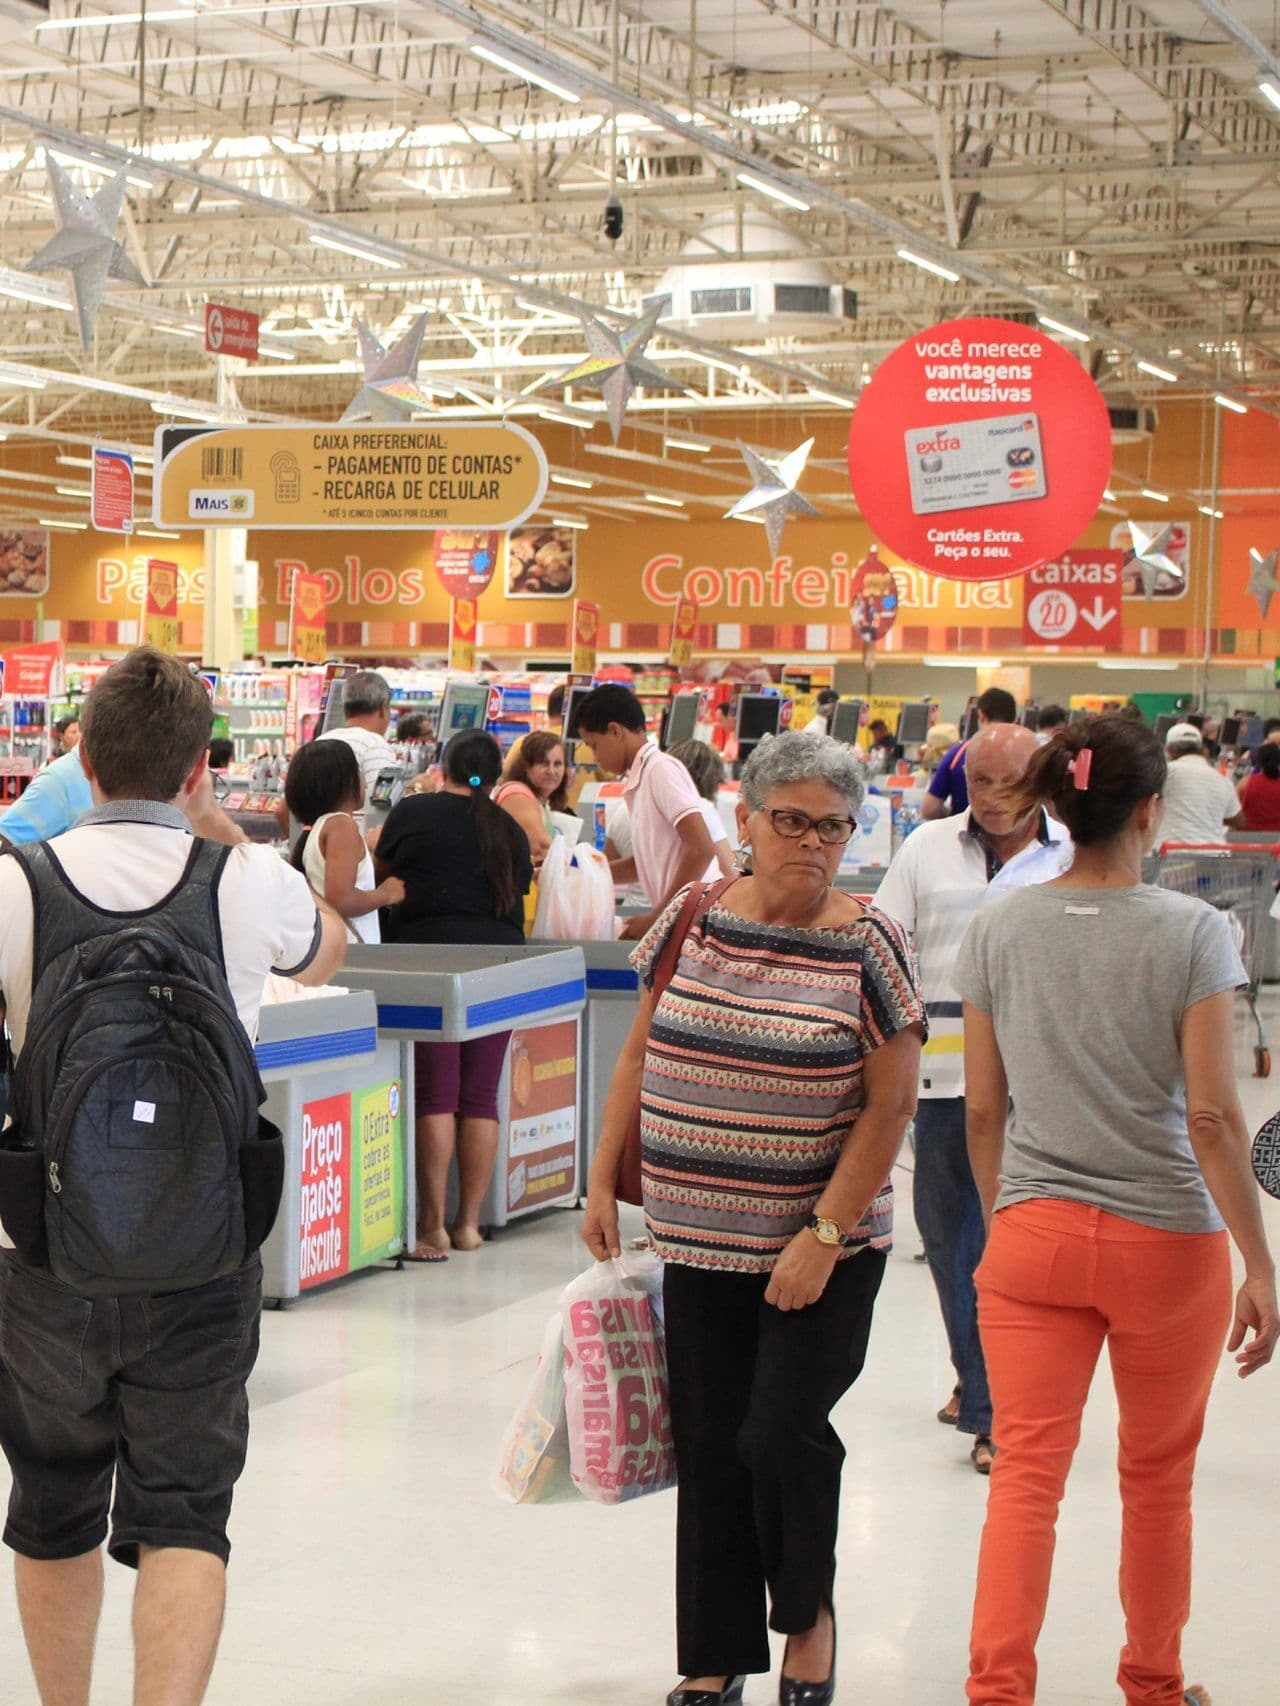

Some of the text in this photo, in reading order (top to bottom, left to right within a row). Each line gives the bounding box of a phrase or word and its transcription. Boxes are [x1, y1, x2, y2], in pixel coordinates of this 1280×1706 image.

[915, 338, 1042, 358] você merece
[924, 362, 1032, 384] vantagens
[925, 383, 1032, 402] exclusivas
[314, 434, 448, 449] CAIXA PREFERENCIAL:
[916, 433, 961, 455] extra
[328, 456, 421, 475] PAGAMENTO
[427, 456, 447, 474] DE
[324, 481, 396, 500] RECARGA
[403, 481, 423, 499] DE
[429, 481, 499, 500] CELULAR
[927, 528, 1024, 542] Cartões Extra.
[935, 544, 1012, 561] Peça o seu.
[1030, 555, 1117, 584] caixas
[1041, 602, 1067, 626] 20
[363, 1113, 390, 1145] O Extra
[303, 1113, 342, 1180] Preço
[300, 1217, 342, 1280] discute
